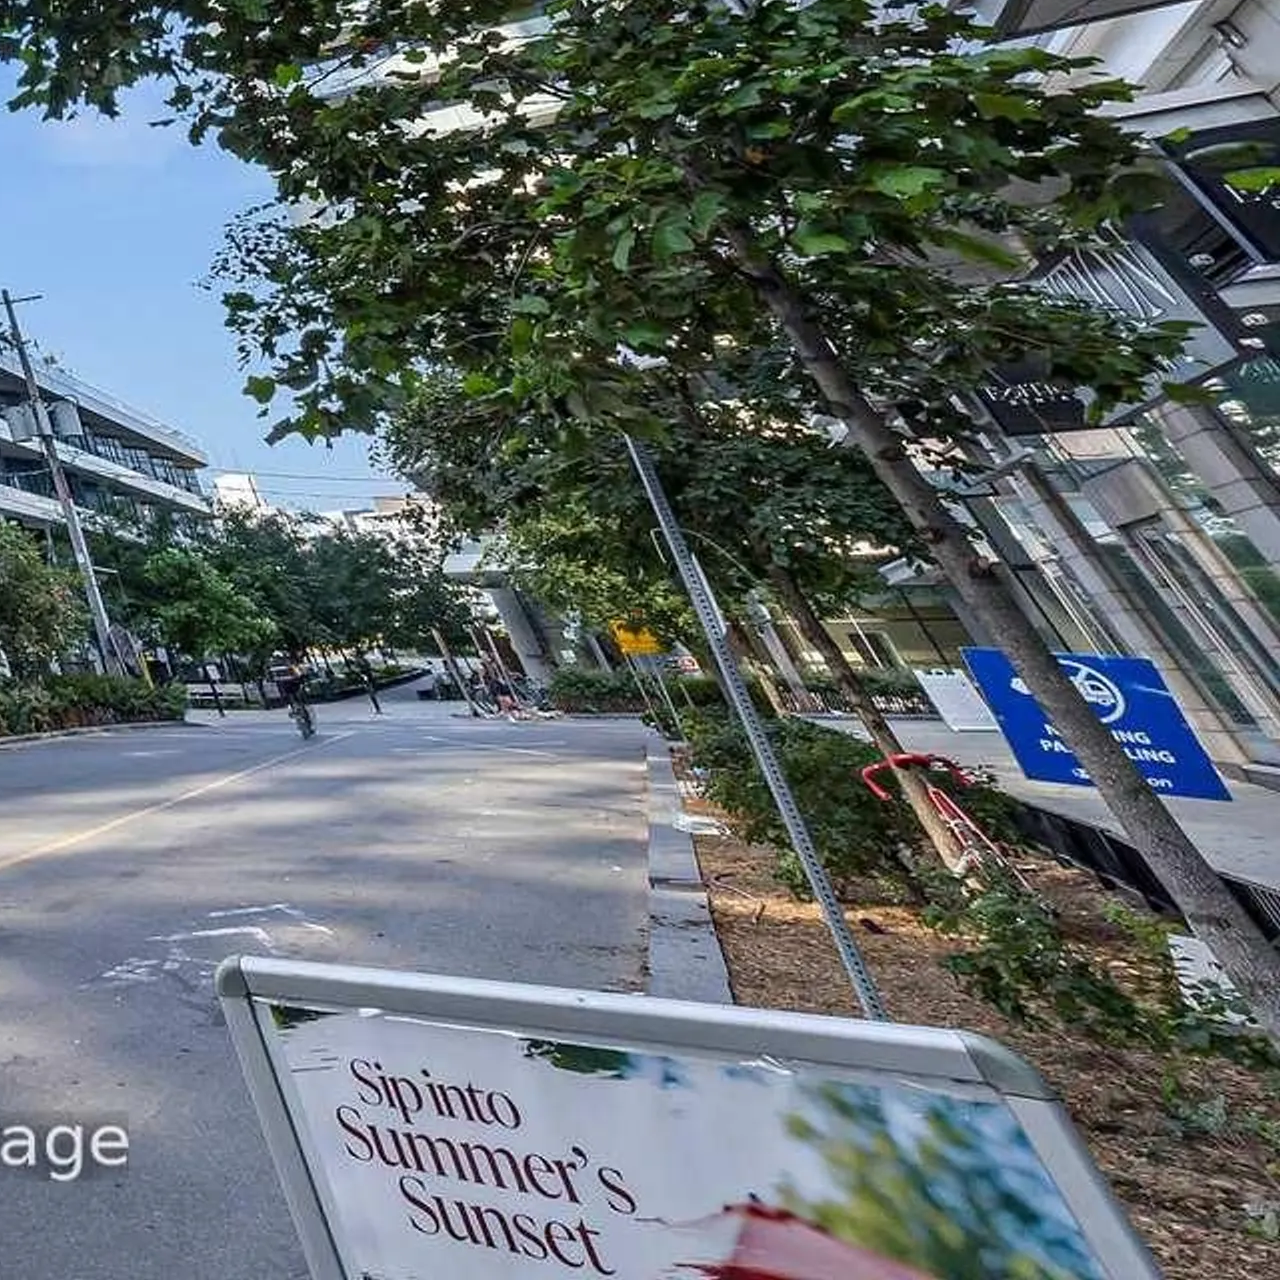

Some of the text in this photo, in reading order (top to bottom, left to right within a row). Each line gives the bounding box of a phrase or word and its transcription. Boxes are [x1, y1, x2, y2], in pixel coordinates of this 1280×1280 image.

[422, 1069, 521, 1130] into
[336, 1105, 636, 1215] Summer's
[399, 1176, 616, 1277] Sunset
